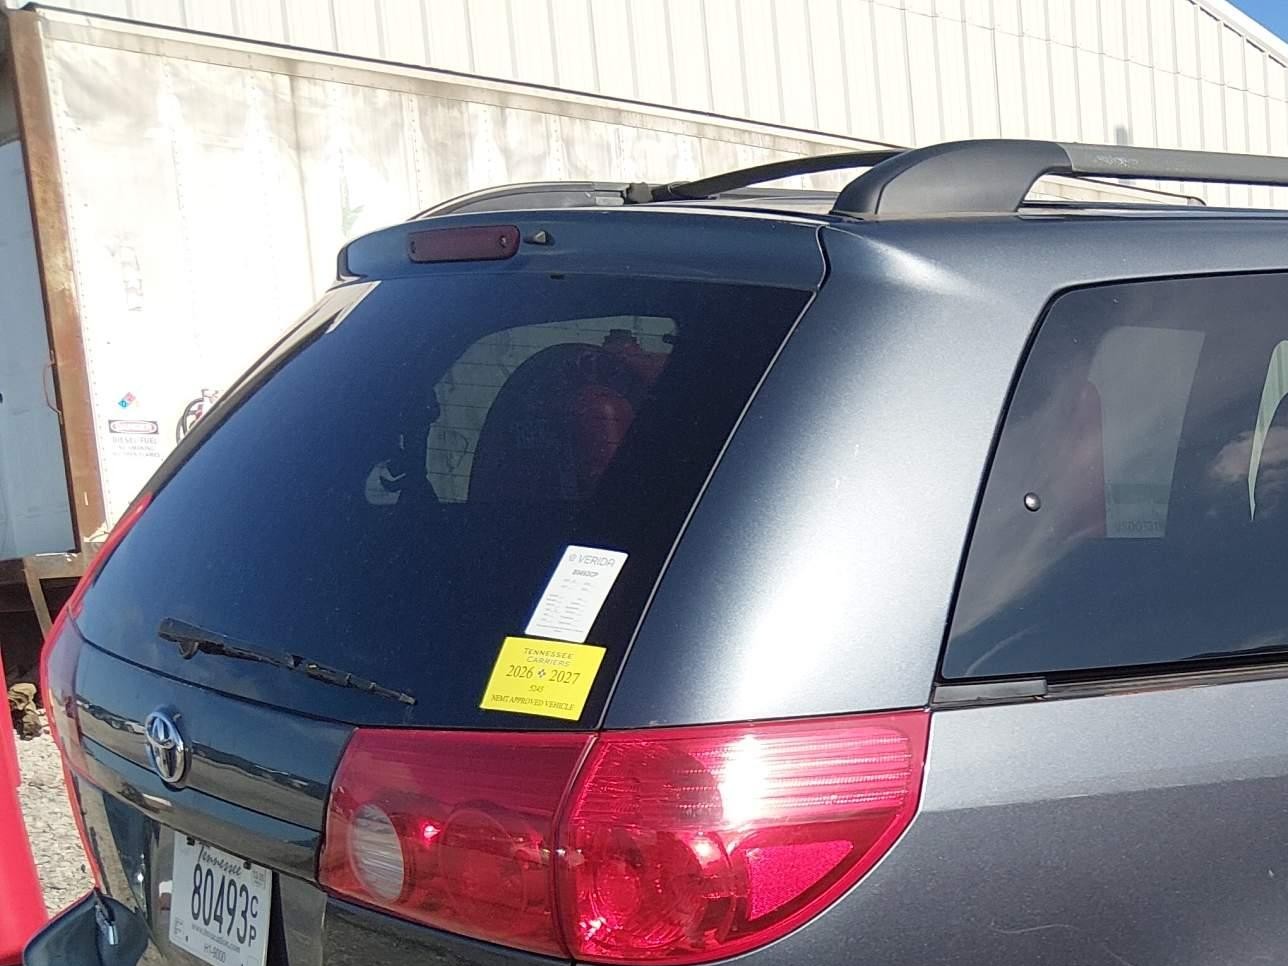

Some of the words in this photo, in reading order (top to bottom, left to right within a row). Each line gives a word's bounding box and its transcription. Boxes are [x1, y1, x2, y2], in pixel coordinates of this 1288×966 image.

[579, 553, 616, 568] VERIDA
[524, 648, 574, 660] TENNESSEE
[527, 656, 571, 667] CARRIERS
[506, 665, 534, 679] 2026
[548, 669, 582, 685] 2027
[510, 696, 544, 706] APPROVED
[545, 700, 577, 711] VEHICLE
[191, 864, 249, 944] 80493
